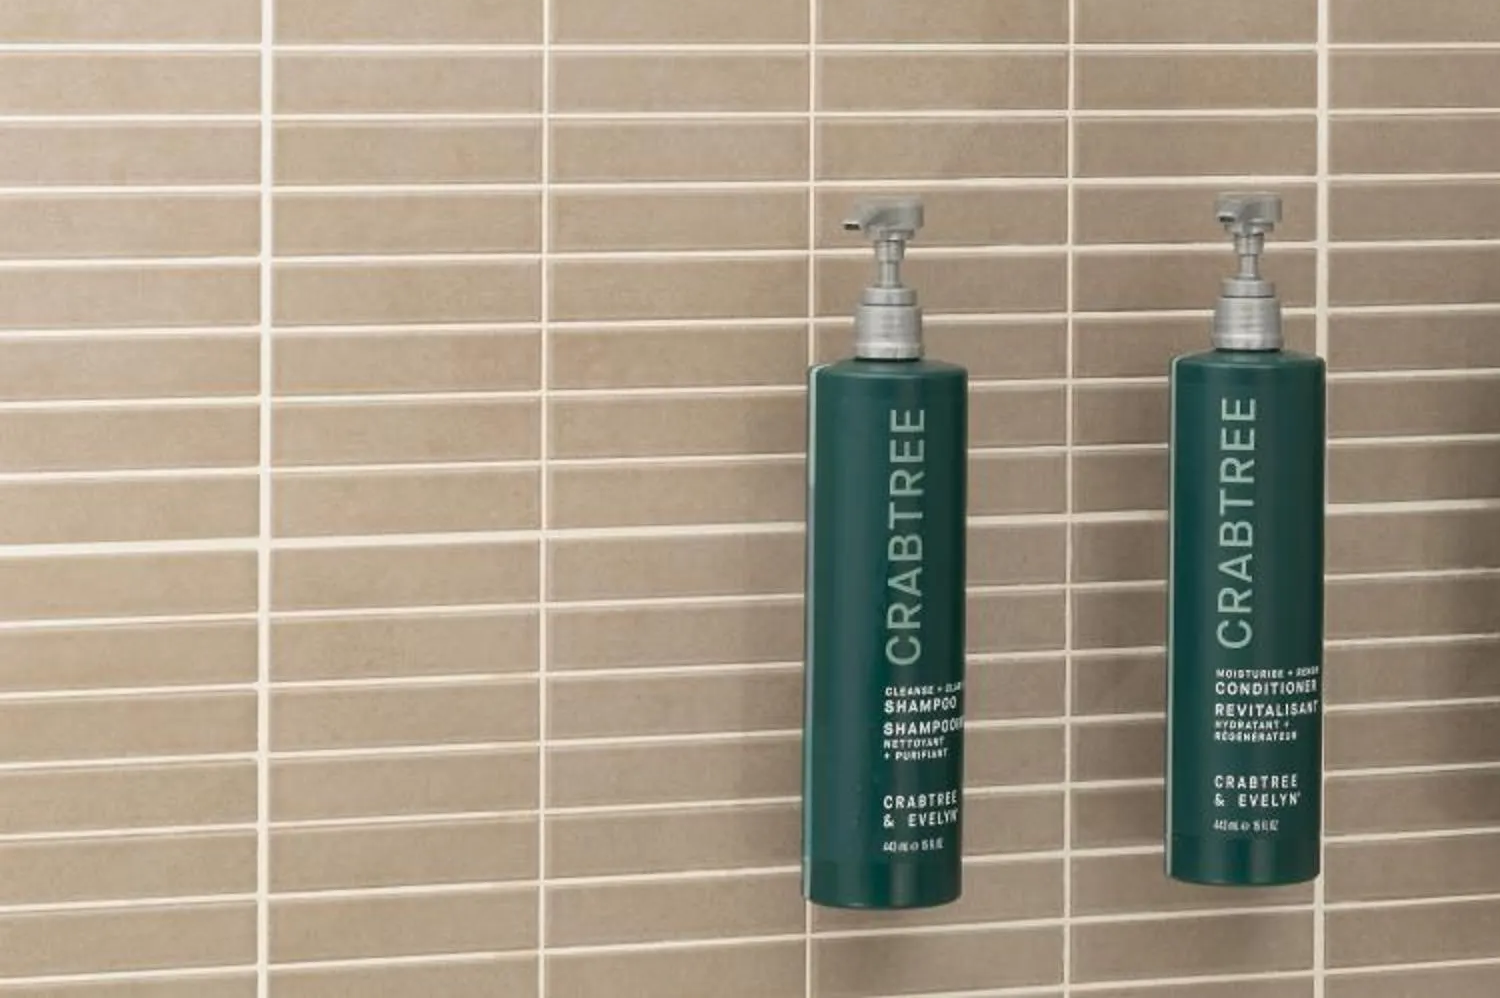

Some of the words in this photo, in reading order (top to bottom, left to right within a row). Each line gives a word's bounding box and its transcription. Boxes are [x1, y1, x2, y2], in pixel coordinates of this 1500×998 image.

[1216, 398, 1257, 649] CRABTREE
[885, 409, 925, 666] CRABTREE
[1215, 679, 1317, 695] CONDITIONER
[884, 695, 957, 715] SHAMPOO
[1215, 700, 1318, 717] REVITALISANT
[1214, 774, 1298, 790] CRABTREE
[883, 790, 958, 809] CRABTREE
[1214, 793, 1225, 807] &
[883, 813, 895, 828] &
